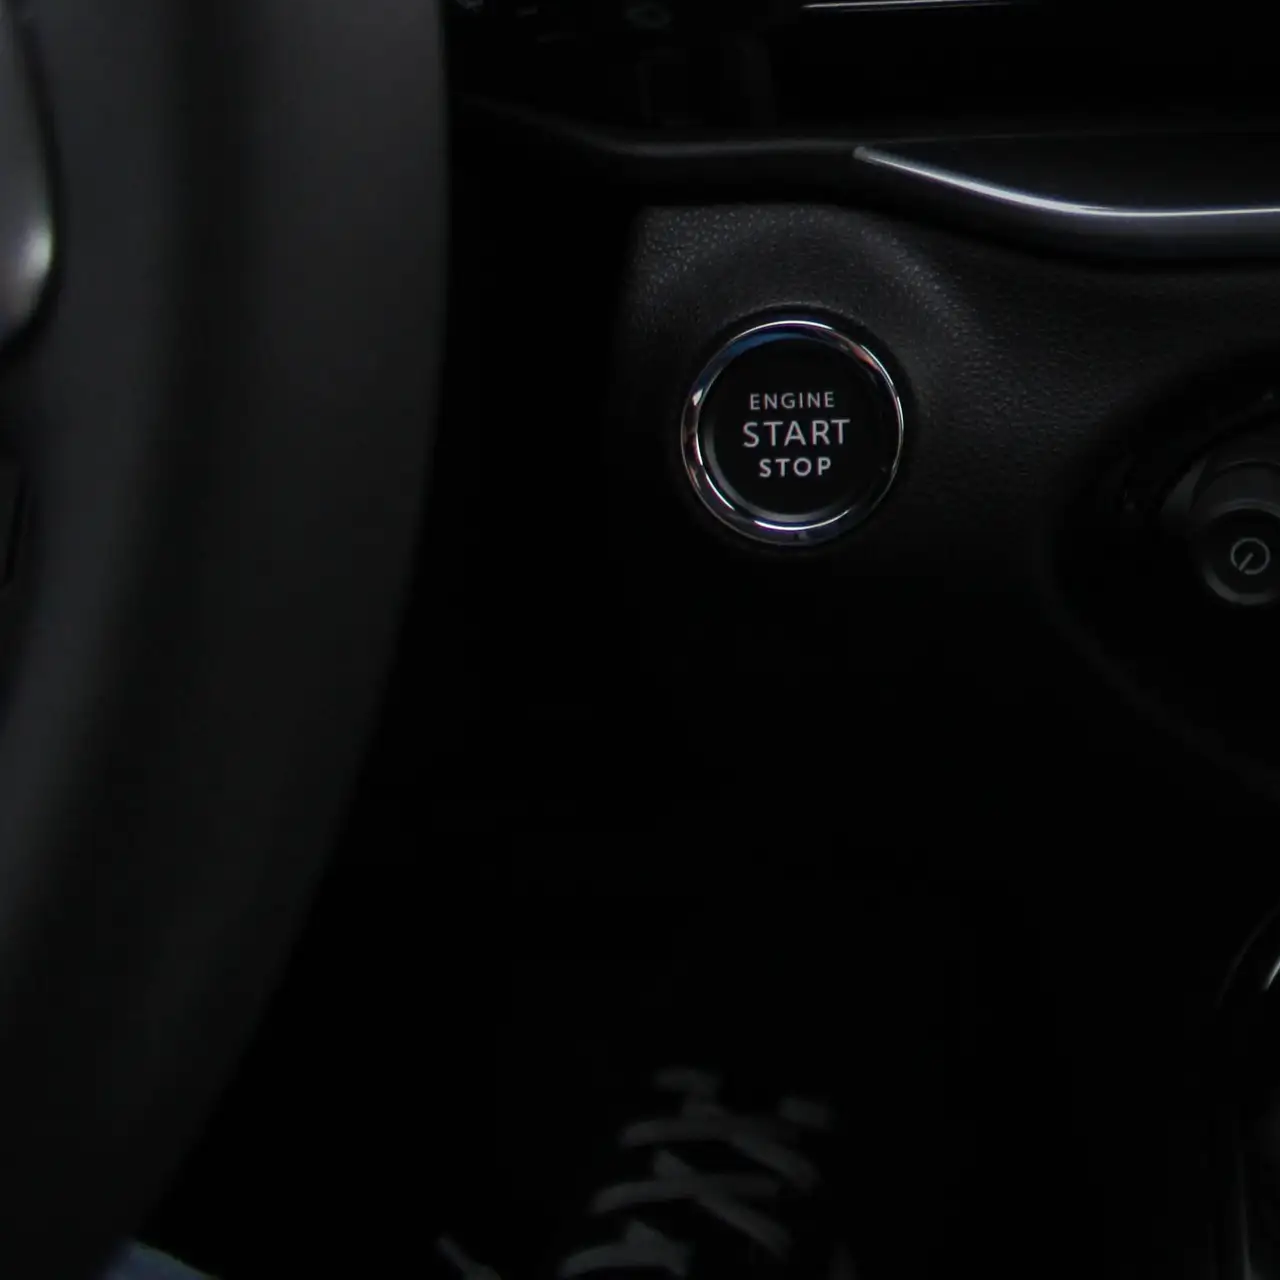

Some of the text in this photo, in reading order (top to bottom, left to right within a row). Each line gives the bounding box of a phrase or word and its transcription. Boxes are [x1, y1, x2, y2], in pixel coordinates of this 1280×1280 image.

[749, 391, 835, 411] ENGINE
[742, 418, 850, 448] START
[759, 456, 832, 478] STOP
